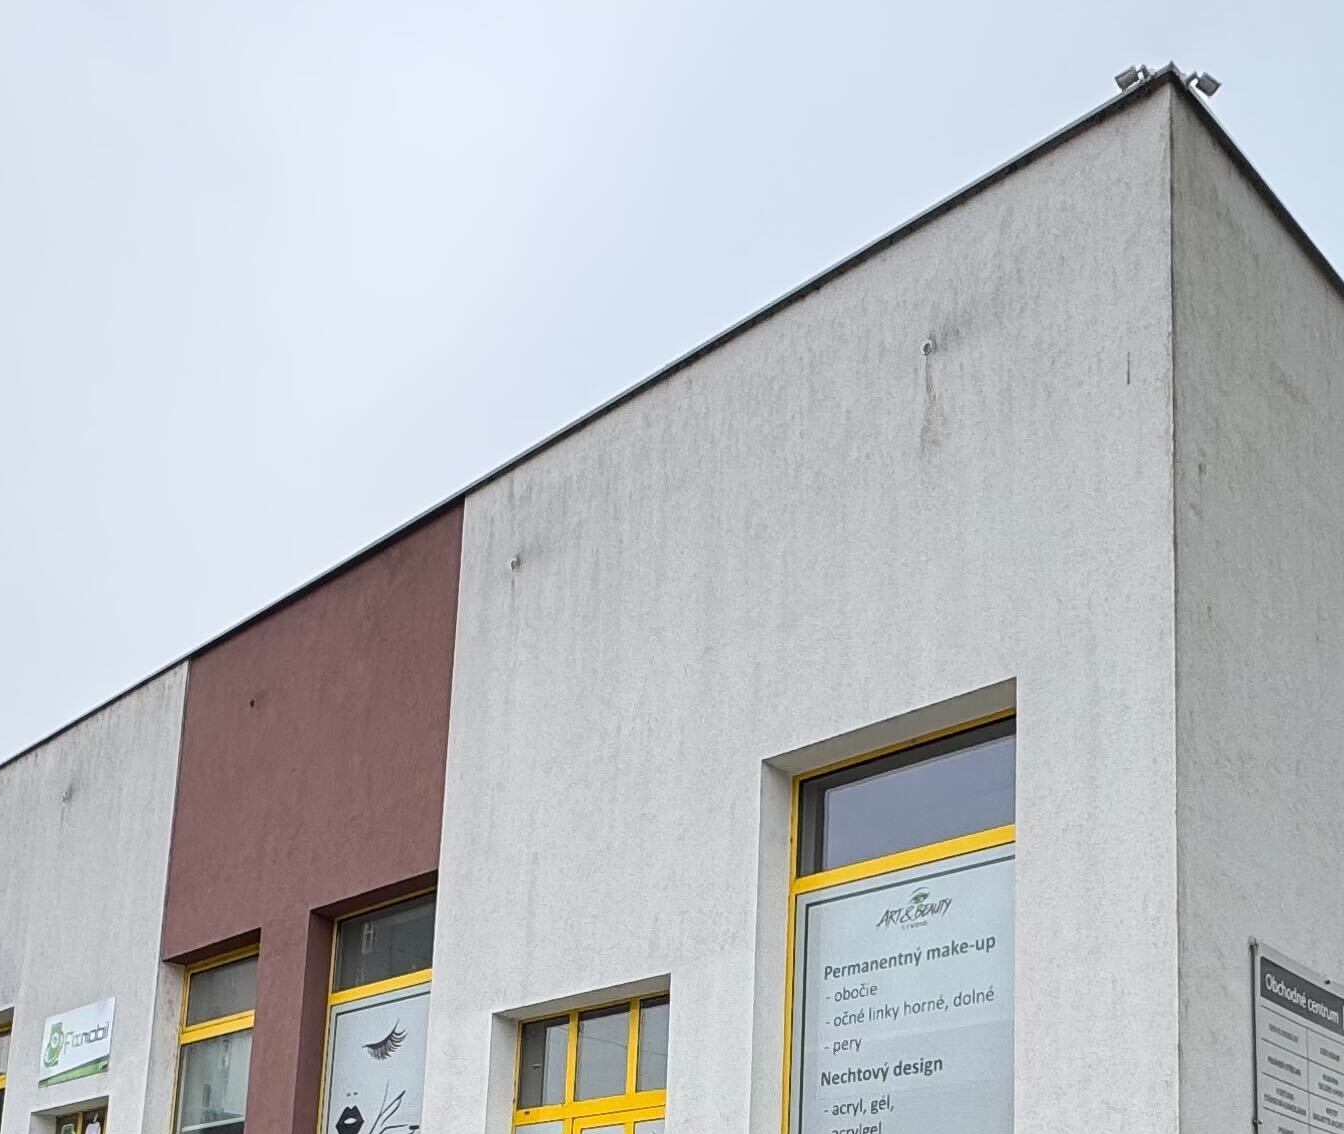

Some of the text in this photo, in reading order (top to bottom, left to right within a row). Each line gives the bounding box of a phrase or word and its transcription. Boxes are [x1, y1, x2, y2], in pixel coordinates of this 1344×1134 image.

[824, 935, 996, 980] Permanentný make-up
[833, 1008, 865, 1027] očné
[869, 1003, 899, 1021] linky
[903, 994, 949, 1012] horné,
[953, 985, 994, 1007] dolné
[834, 983, 878, 1002] obočie
[1265, 973, 1306, 1009] Obchodné
[1307, 999, 1339, 1024] centrum
[832, 1037, 862, 1055] pery
[820, 1057, 943, 1086] Nechtový design
[832, 1098, 867, 1116] acryl,
